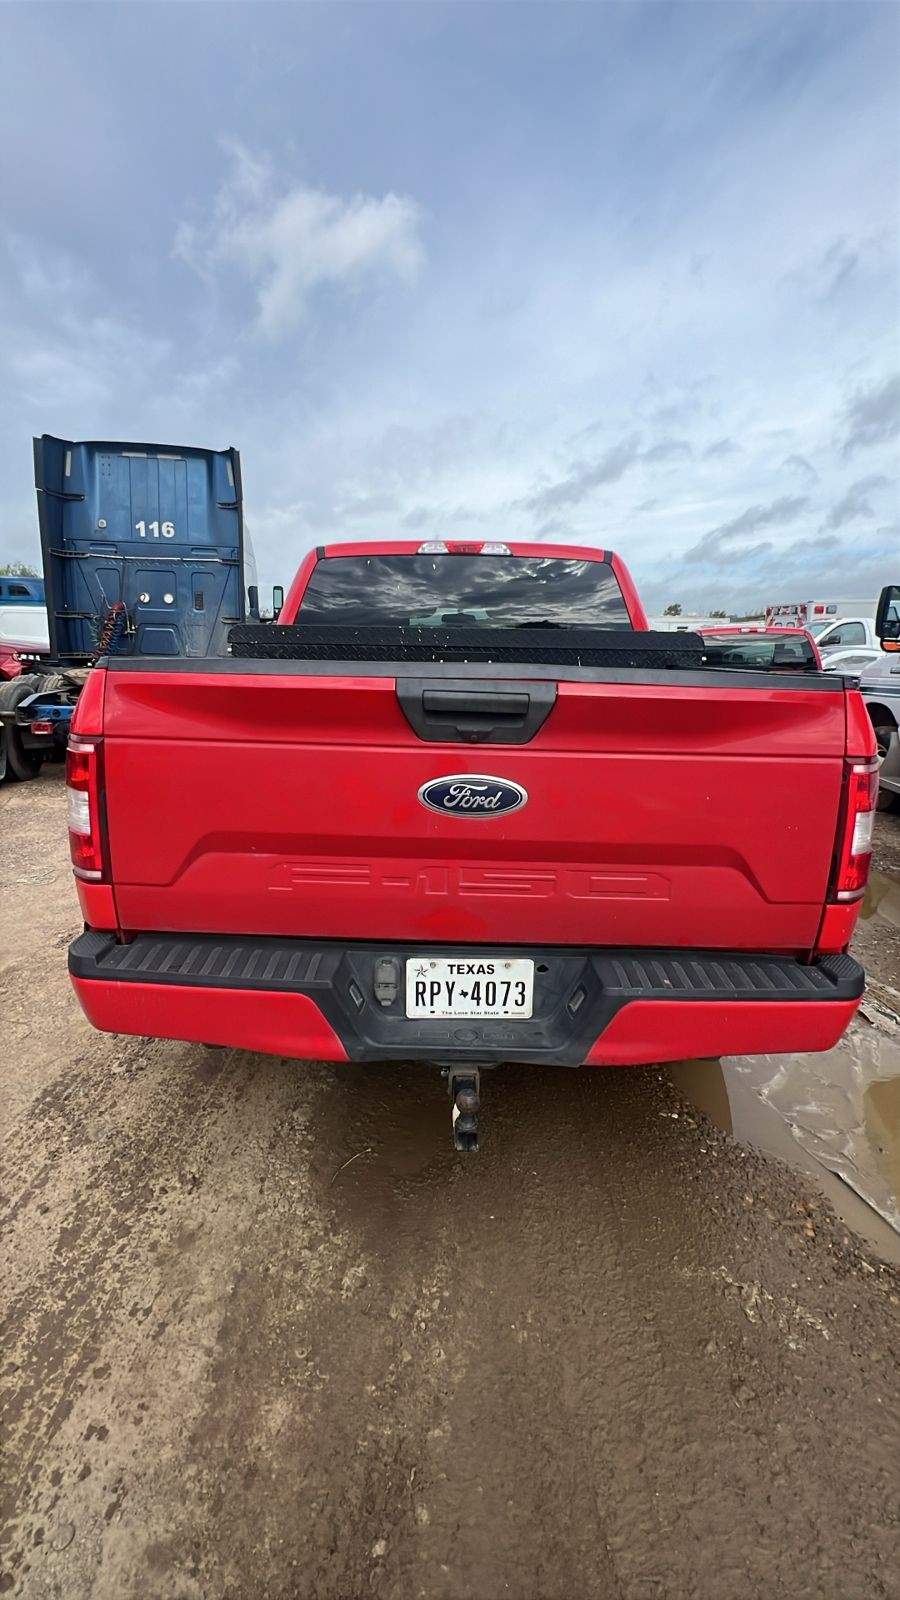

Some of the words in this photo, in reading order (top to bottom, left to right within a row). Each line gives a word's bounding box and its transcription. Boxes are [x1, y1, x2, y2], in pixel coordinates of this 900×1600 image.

[135, 521, 175, 538] 116
[443, 783, 503, 809] Ford
[268, 862, 671, 901] F-150
[447, 964, 495, 975] TEXAS
[415, 981, 456, 1007] RPY
[470, 981, 526, 1007] 4073
